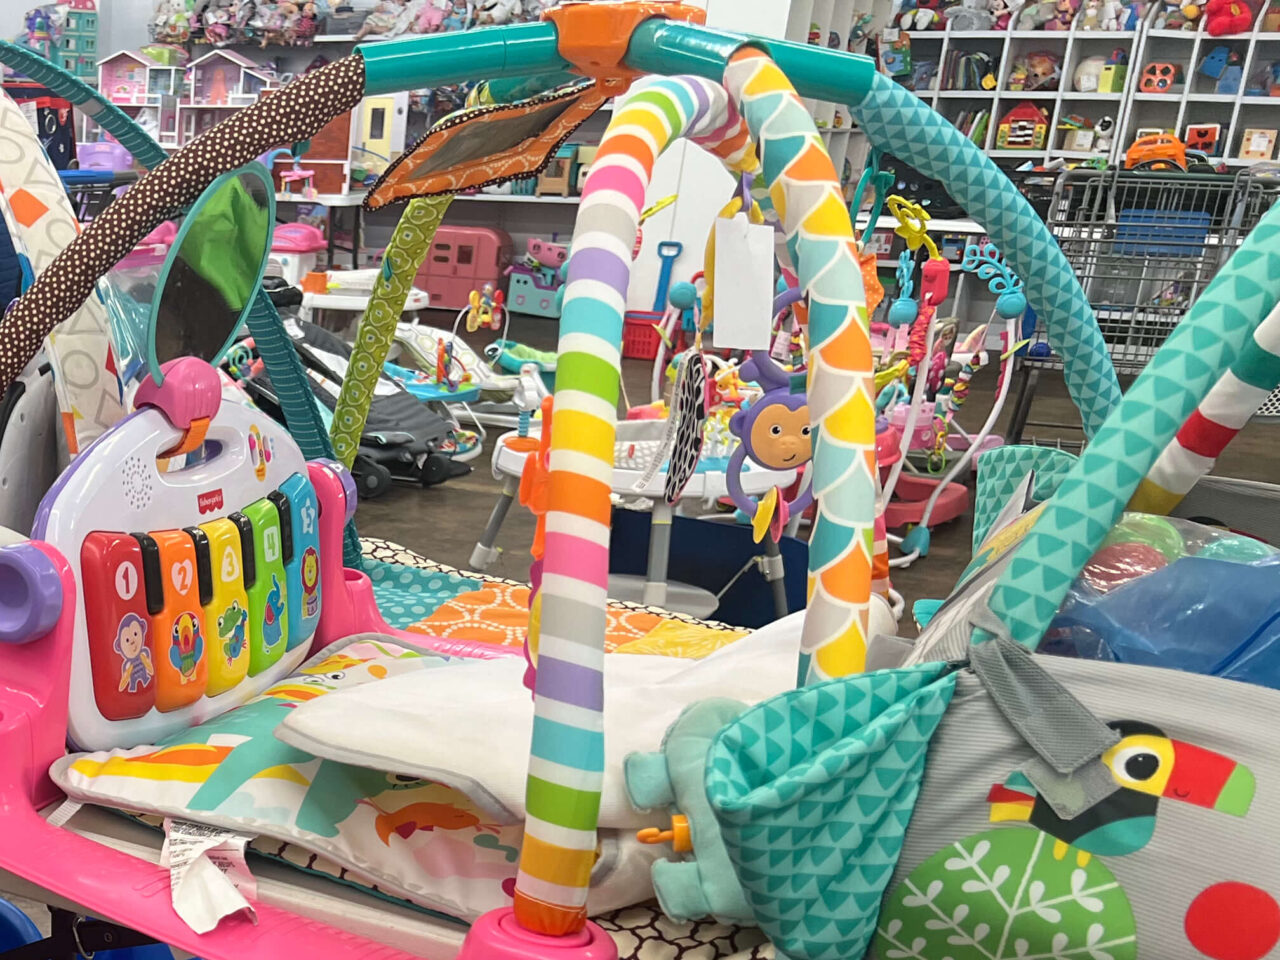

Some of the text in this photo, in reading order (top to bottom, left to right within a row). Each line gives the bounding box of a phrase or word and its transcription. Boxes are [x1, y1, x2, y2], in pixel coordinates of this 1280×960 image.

[177, 565, 187, 590] 2
[225, 554, 235, 576] 3
[122, 567, 130, 594] 1
